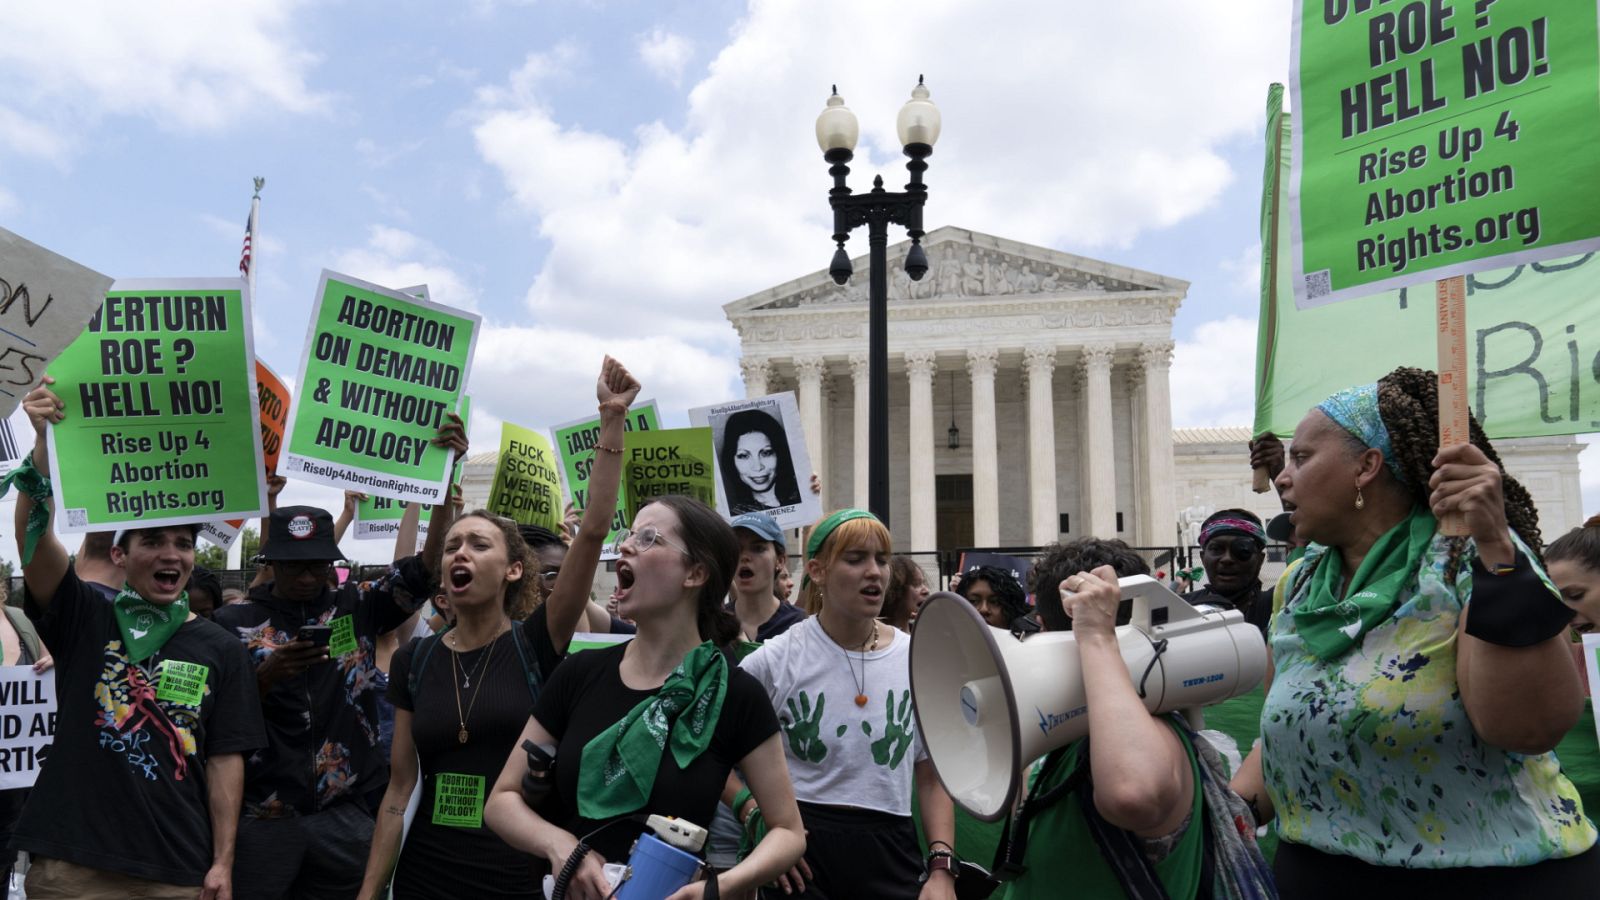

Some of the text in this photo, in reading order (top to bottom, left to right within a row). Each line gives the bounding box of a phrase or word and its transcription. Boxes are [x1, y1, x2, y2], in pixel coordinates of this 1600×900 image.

[1369, 1, 1456, 68] ROE
[1340, 16, 1549, 139] HELL NO!
[1358, 110, 1519, 184] Rise Up 4
[1364, 164, 1514, 226] Abortion
[1356, 207, 1541, 272] Rights.org
[337, 295, 456, 352] ABORTION
[100, 338, 195, 375] ROE ?
[315, 332, 460, 393] ON DEMAND
[79, 380, 224, 418] HELL NO!
[313, 378, 448, 430] & WITHOUT
[101, 429, 210, 456] Rise Up 4
[315, 417, 430, 467] APOLOGY
[509, 440, 545, 462] FUCK
[631, 446, 681, 462] FUCK
[110, 460, 209, 485] Abortion
[302, 460, 440, 500] RiseUp4AbortionRights.org
[506, 458, 557, 484] SCOTUS
[631, 462, 705, 480] SCOTUS
[504, 476, 551, 498] WE'RE
[633, 482, 691, 498] WE'RE
[106, 489, 226, 517] Rights.org
[499, 493, 550, 514] DOING
[441, 774, 480, 788] ABORTION
[450, 787, 478, 797] DEMAND
[445, 794, 477, 806] WITHOUT
